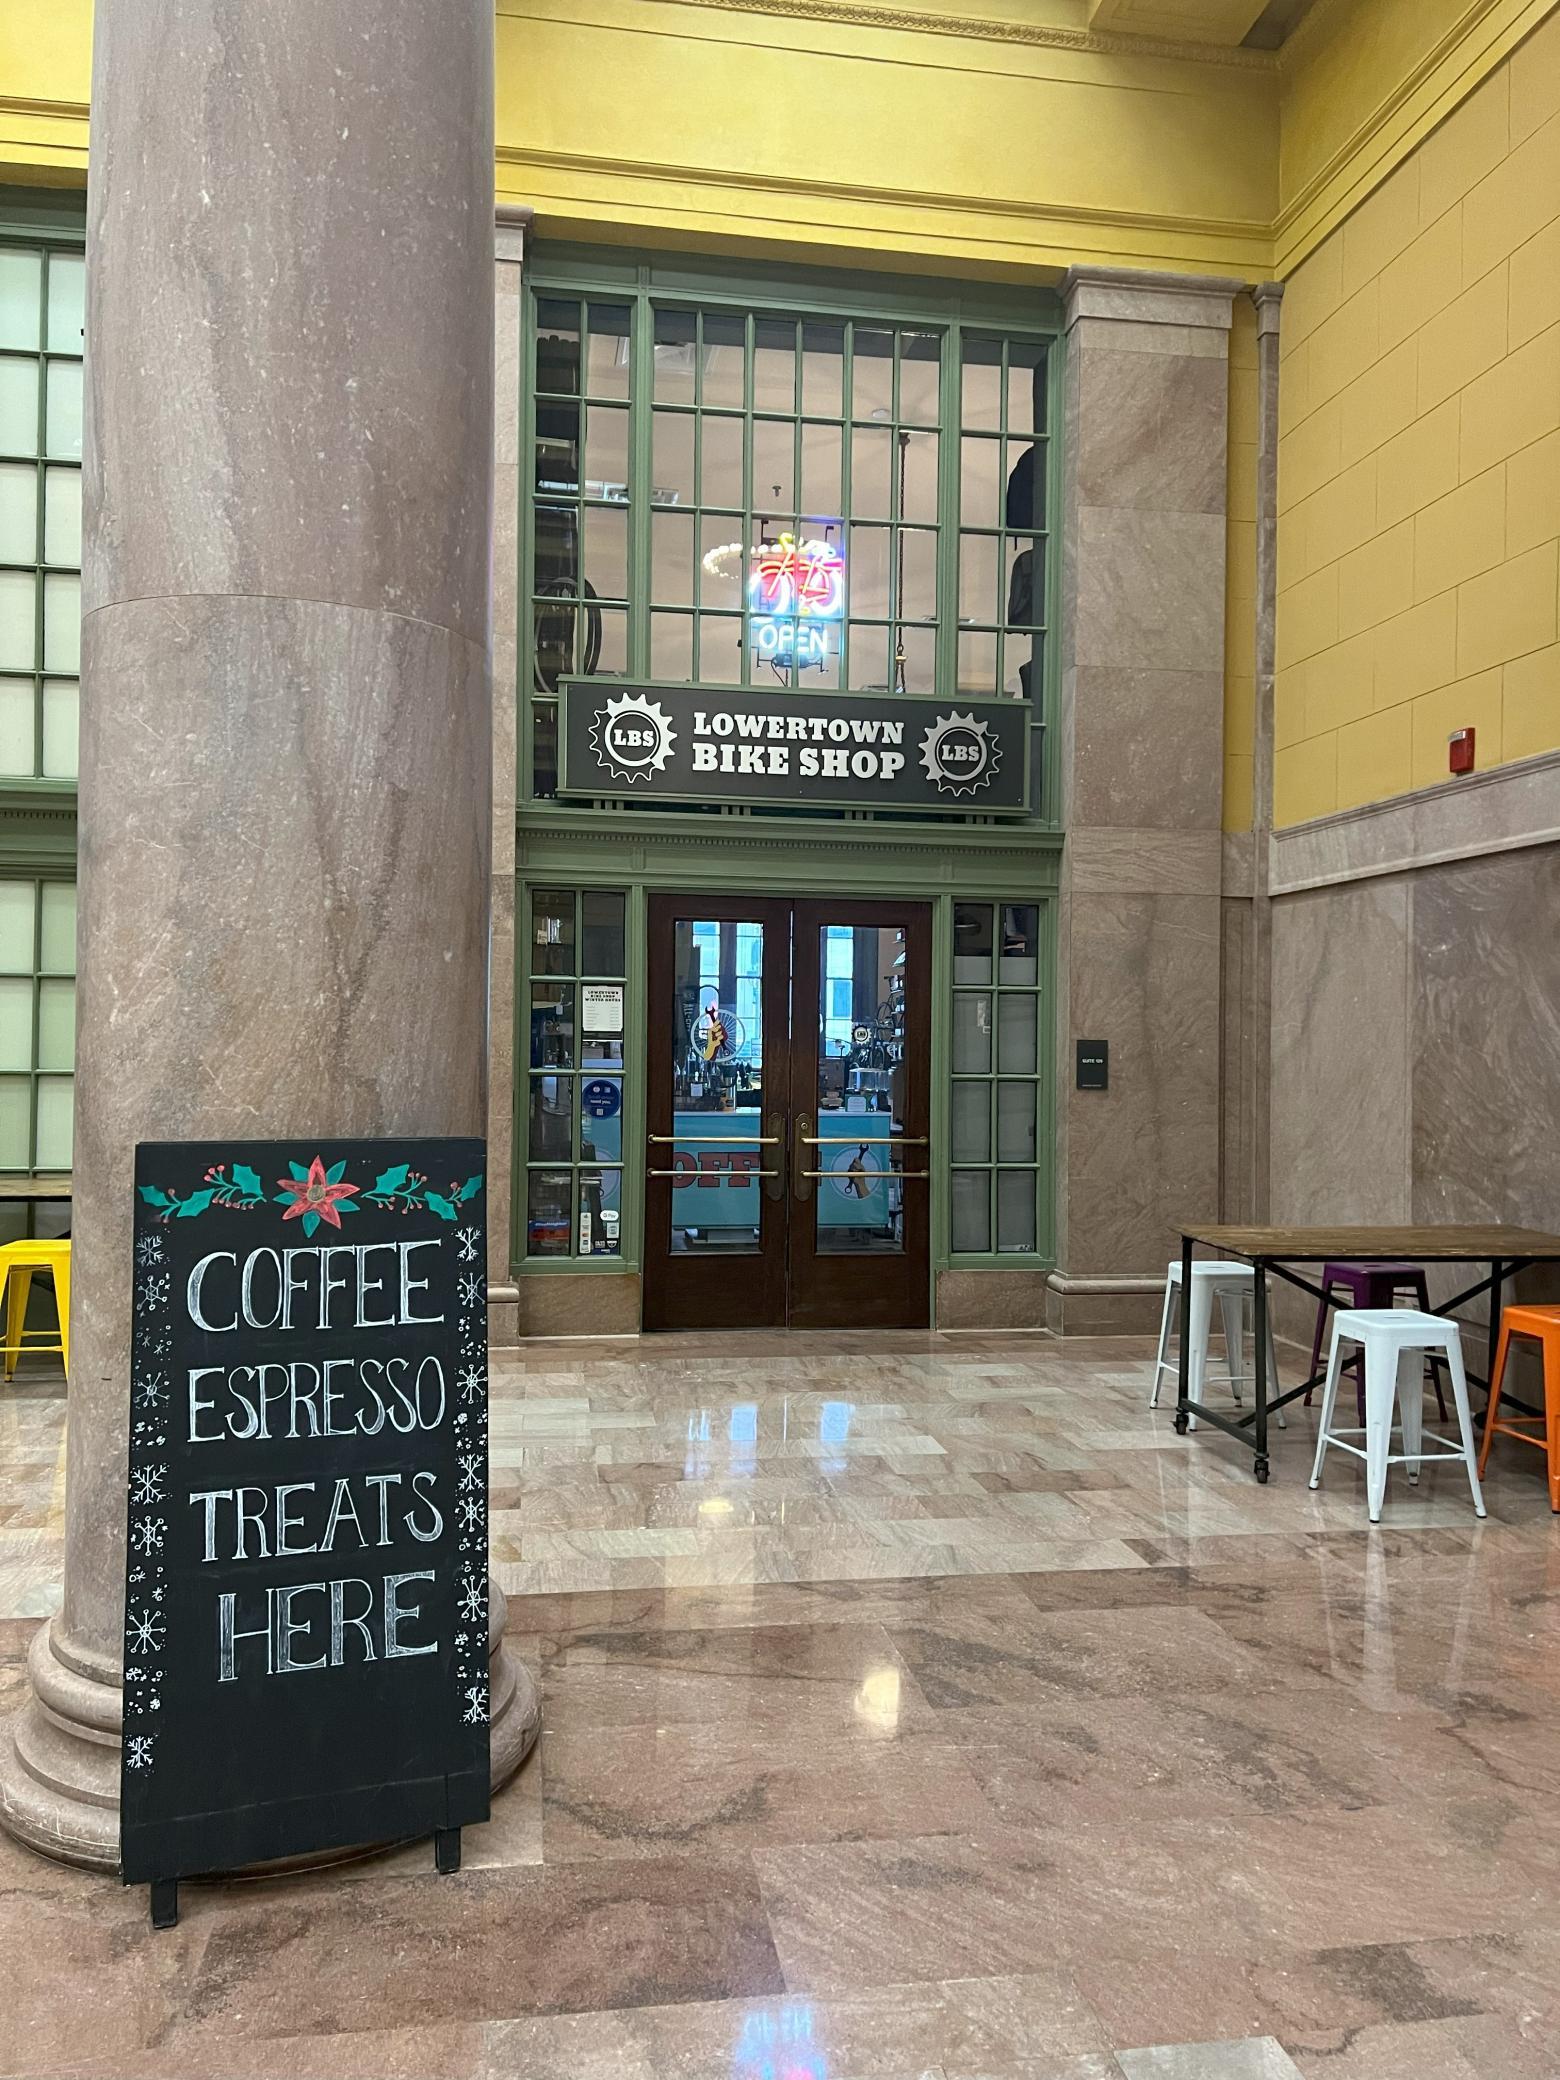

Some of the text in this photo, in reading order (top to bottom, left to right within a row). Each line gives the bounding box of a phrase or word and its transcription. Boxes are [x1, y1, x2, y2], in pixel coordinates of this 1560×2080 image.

[758, 623, 828, 655] OPEN
[613, 728, 655, 747] LBS
[693, 711, 905, 745] LOWERTOWN
[692, 742, 905, 780] BIKE SHOP
[941, 744, 980, 762] LBS
[187, 1238, 445, 1332] COFFEE
[187, 1356, 446, 1442] ESPRESSO
[189, 1471, 444, 1562] TREATS
[217, 1570, 438, 1682] HERE
